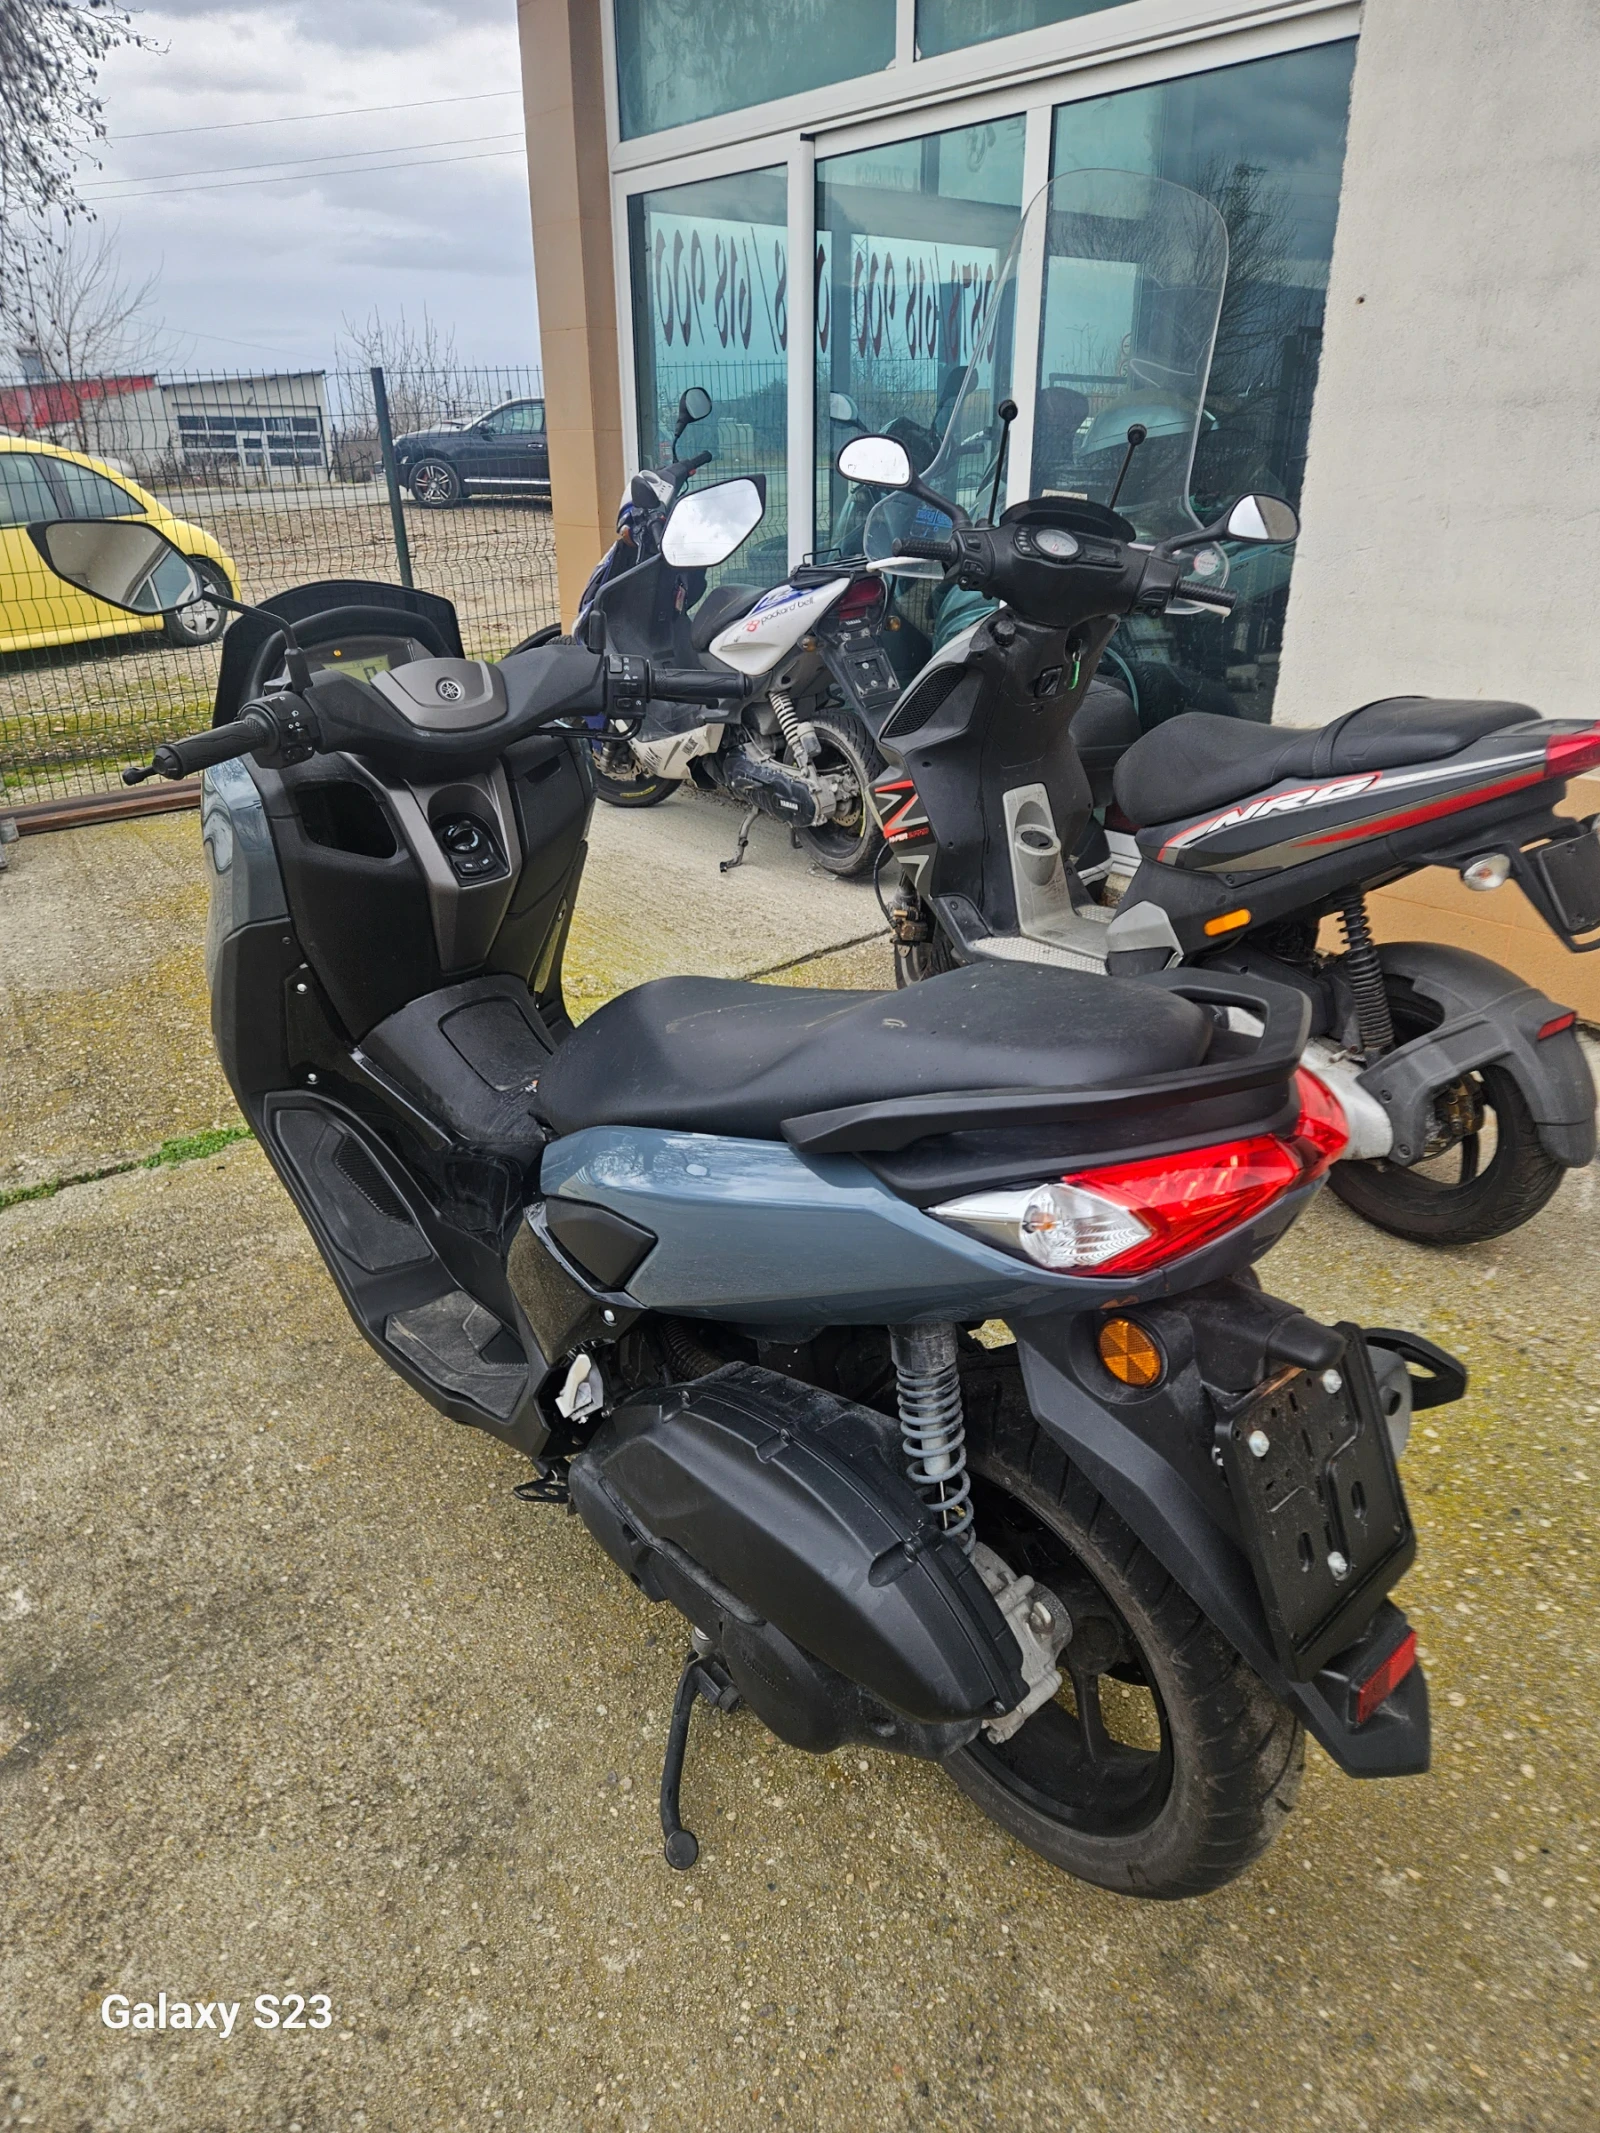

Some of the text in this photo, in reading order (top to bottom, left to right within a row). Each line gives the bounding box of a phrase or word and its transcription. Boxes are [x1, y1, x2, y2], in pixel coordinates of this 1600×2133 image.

[761, 603, 797, 626] packard
[797, 596, 815, 608] bell
[1206, 774, 1379, 834] NRG
